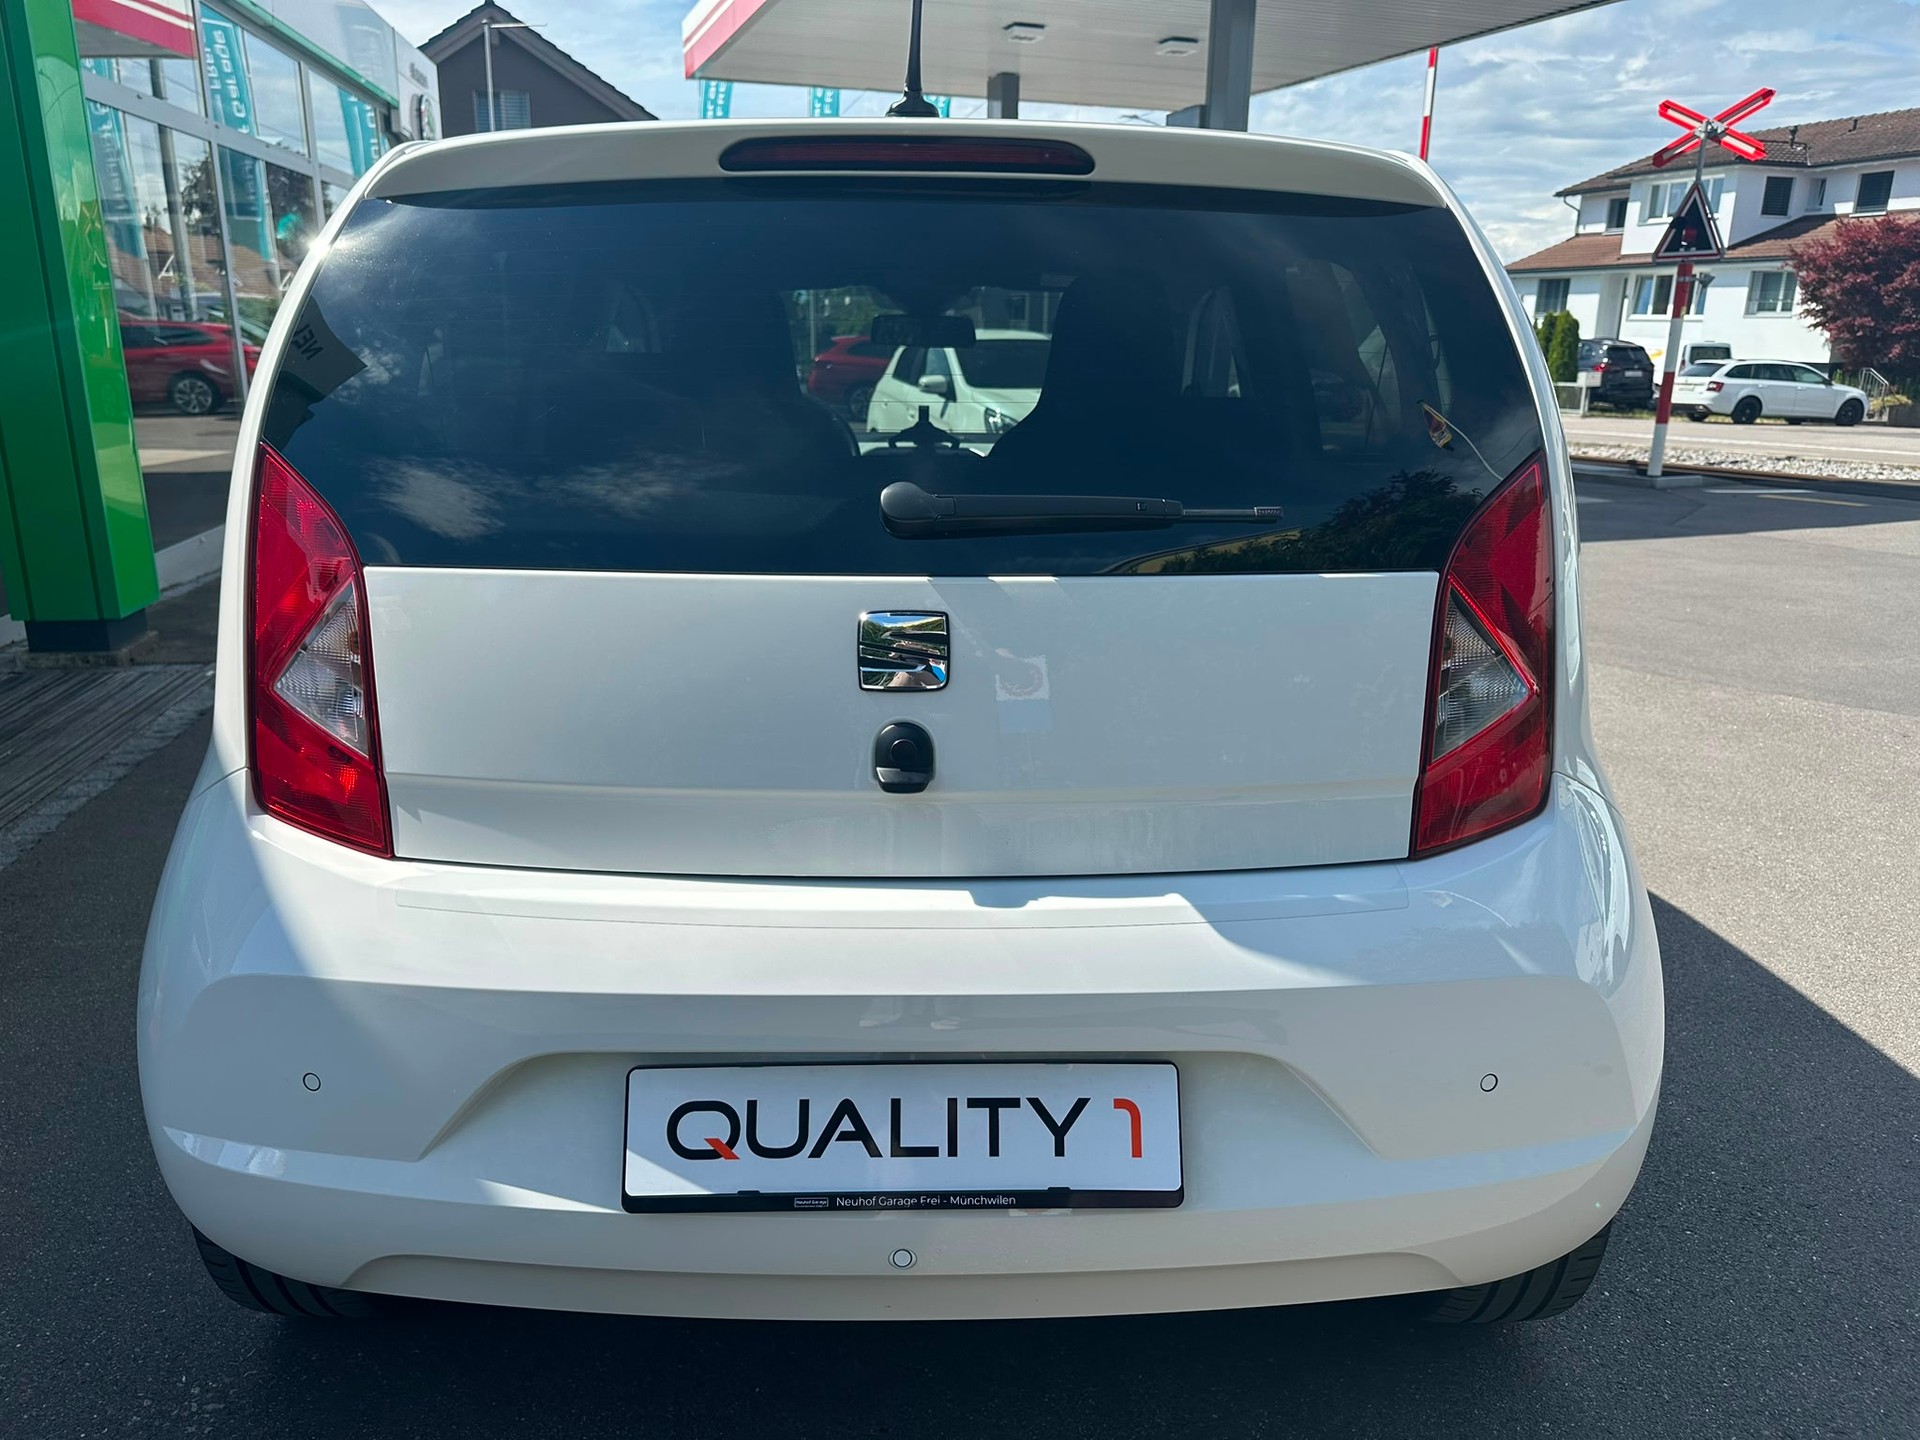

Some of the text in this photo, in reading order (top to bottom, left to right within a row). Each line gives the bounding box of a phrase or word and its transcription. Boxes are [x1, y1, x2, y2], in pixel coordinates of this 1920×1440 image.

[667, 1098, 1142, 1160] QUALITY 1
[836, 1196, 876, 1206] Neuhof
[878, 1196, 918, 1208] Garage
[920, 1195, 941, 1205] Frei
[950, 1194, 1016, 1205] Münchwilen
